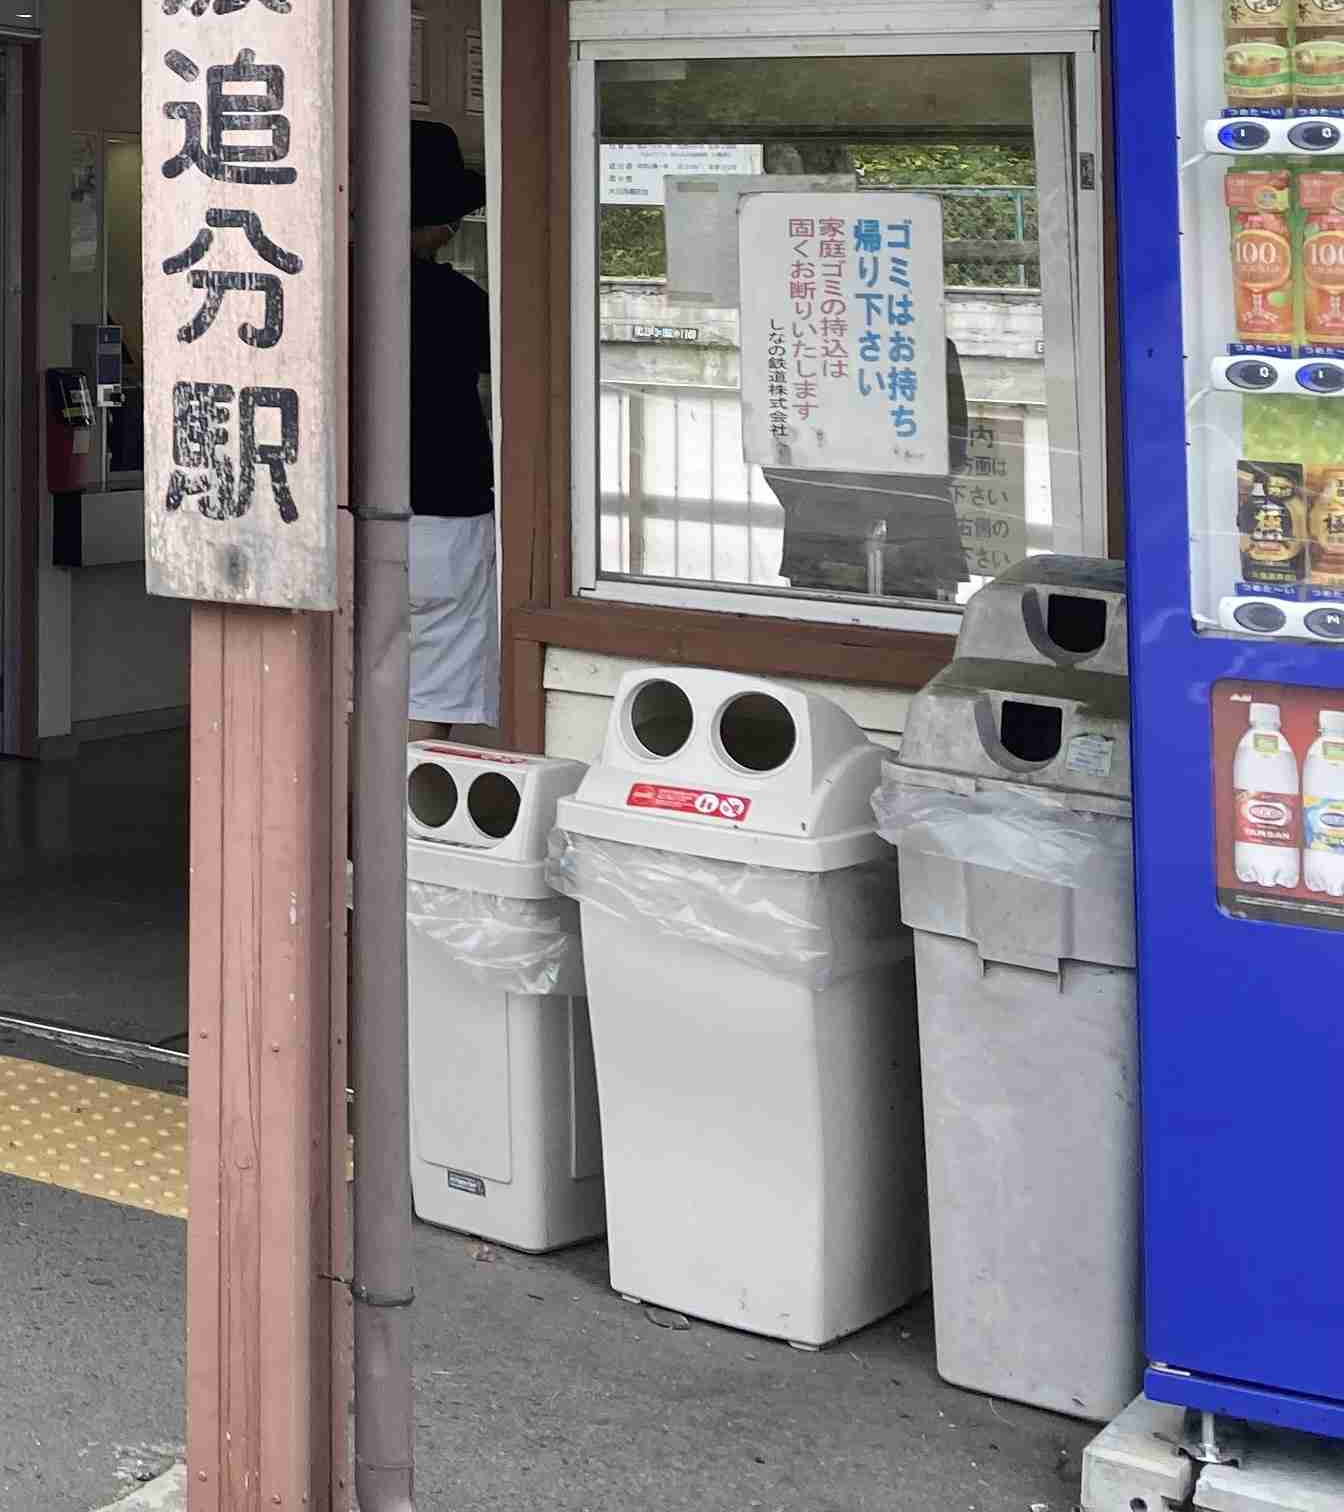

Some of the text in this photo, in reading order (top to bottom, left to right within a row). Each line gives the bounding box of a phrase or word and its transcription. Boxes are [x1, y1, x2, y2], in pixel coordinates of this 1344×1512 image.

[768, 318, 789, 439] しなの鉄道株式会社
[788, 218, 819, 421] 固くお断りいたします
[818, 218, 850, 379] 家庭ゴミの持込は
[853, 218, 886, 397] 帰り下さい
[886, 218, 917, 439] ゴミはお持ち
